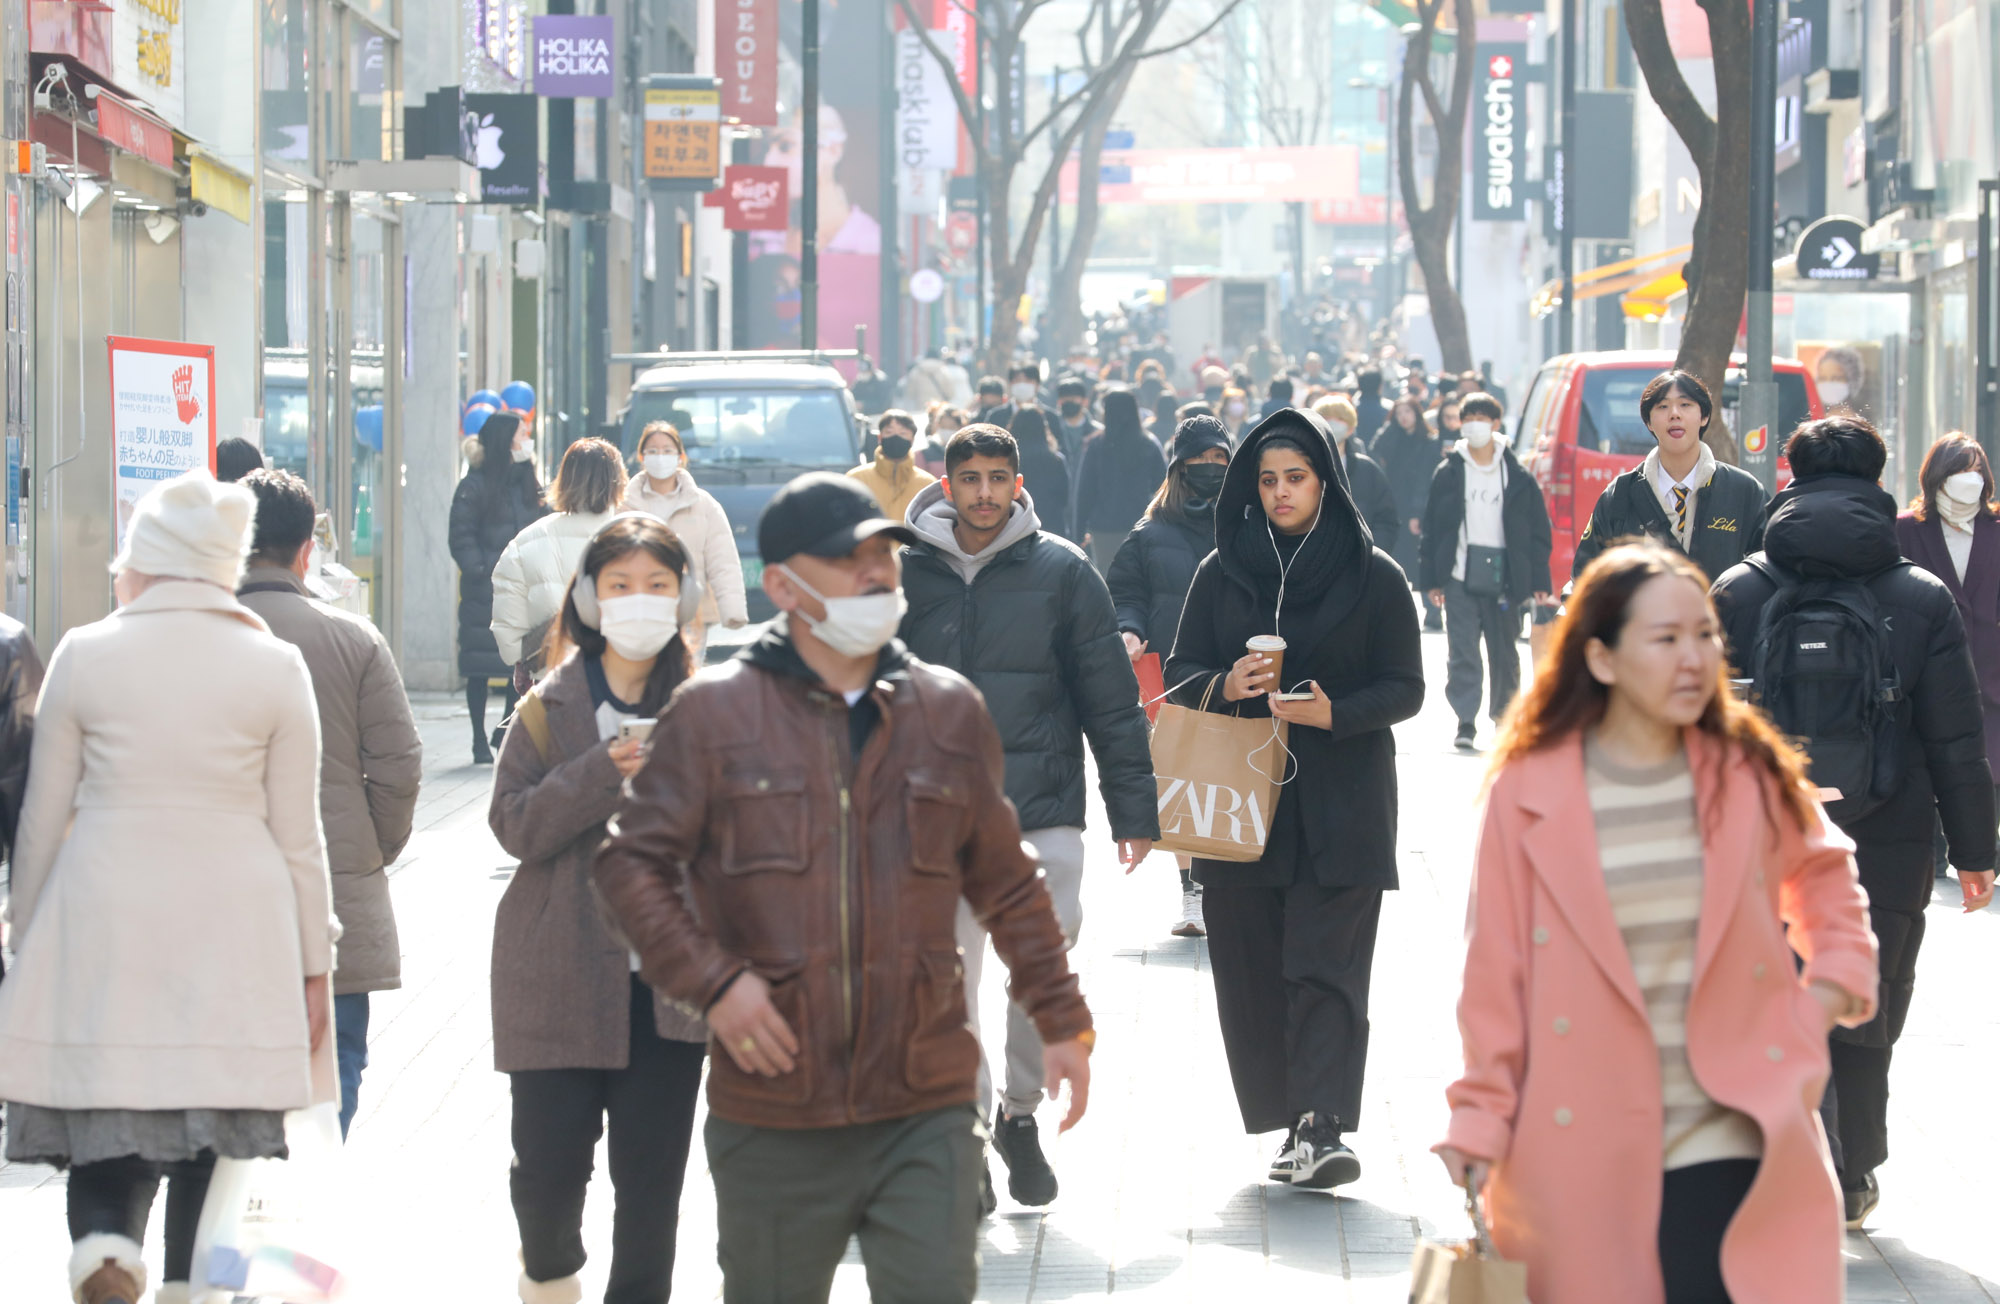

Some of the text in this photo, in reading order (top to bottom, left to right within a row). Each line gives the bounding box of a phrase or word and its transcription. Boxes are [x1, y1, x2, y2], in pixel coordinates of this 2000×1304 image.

[539, 38, 609, 56] HOLIKA
[539, 56, 609, 75] HOLIKA
[903, 29, 931, 167] masklab
[1484, 78, 1513, 209] swatch
[175, 380, 190, 393] HIT
[136, 467, 154, 479] FOOT
[1707, 516, 1738, 533] Lila
[1155, 776, 1266, 847] ZARA
